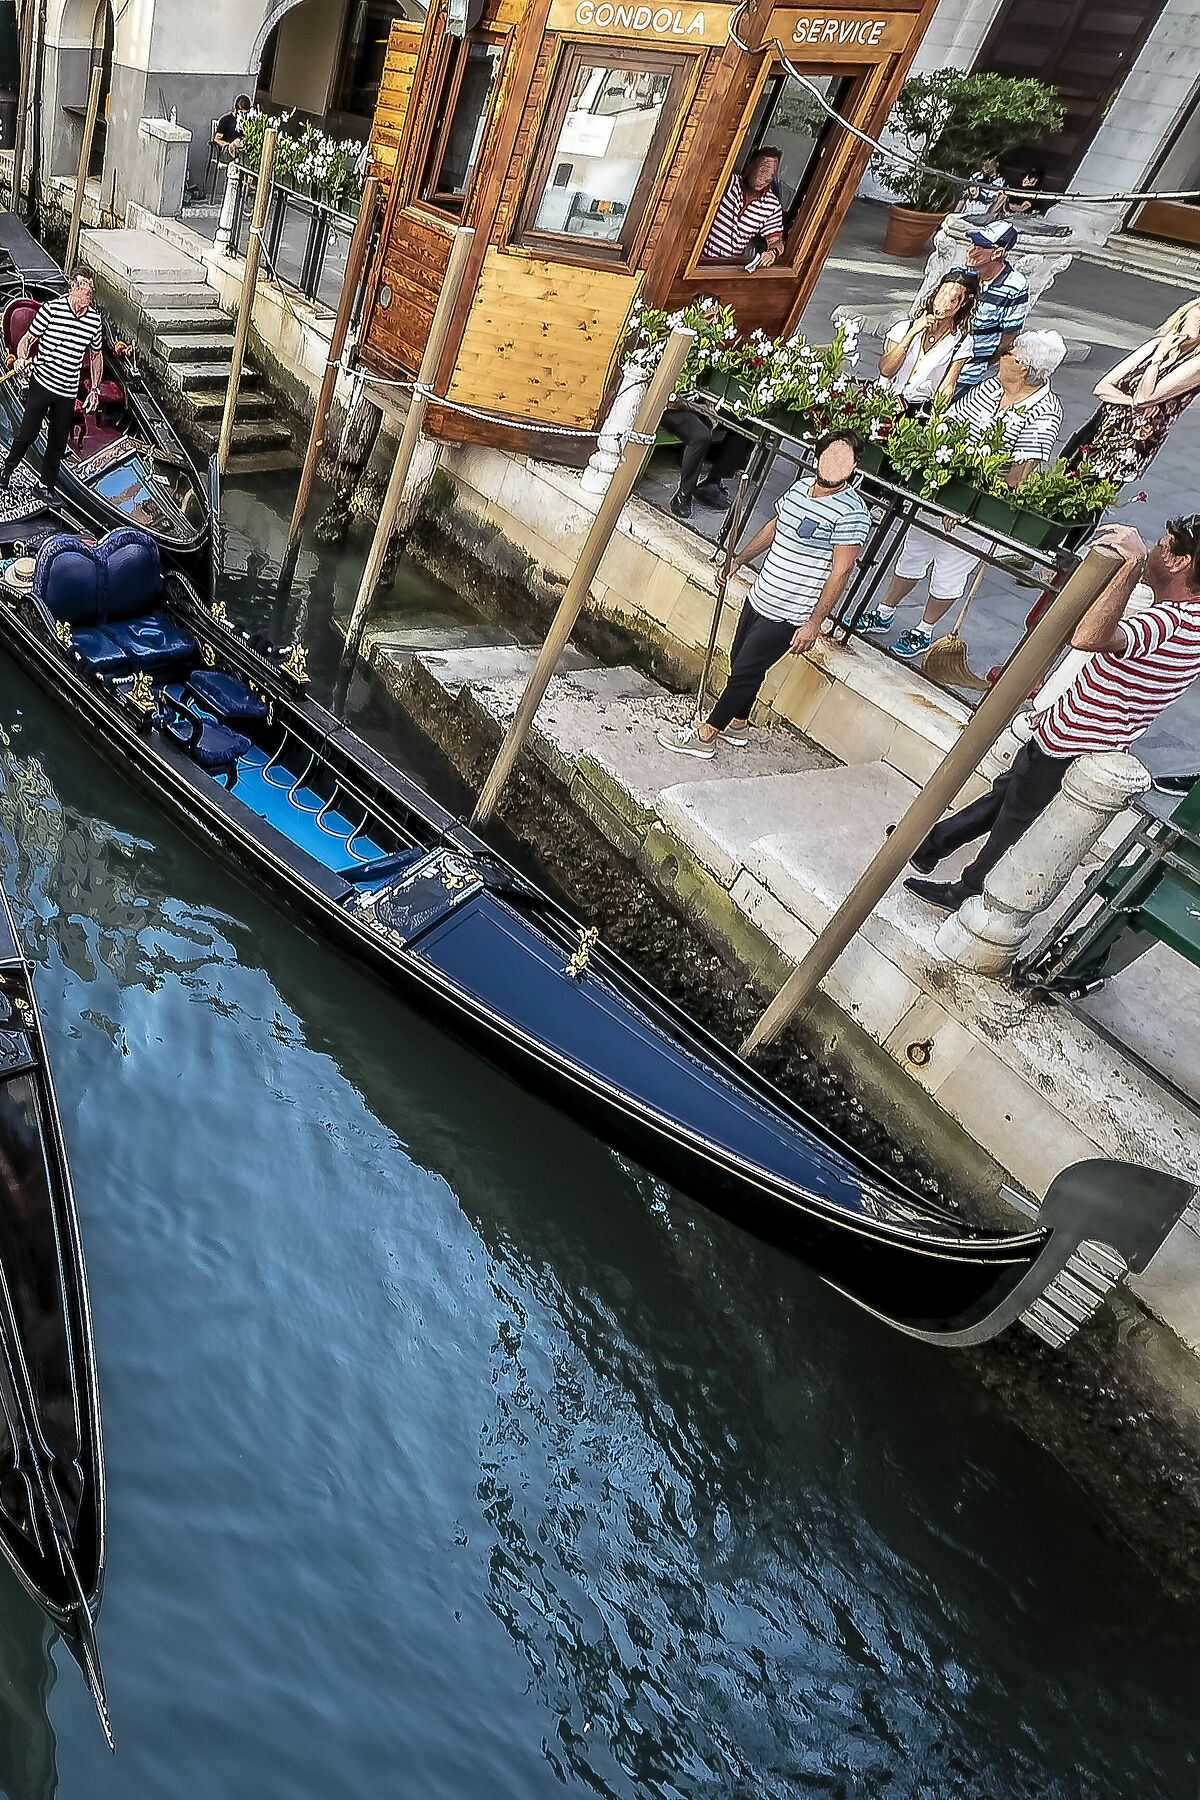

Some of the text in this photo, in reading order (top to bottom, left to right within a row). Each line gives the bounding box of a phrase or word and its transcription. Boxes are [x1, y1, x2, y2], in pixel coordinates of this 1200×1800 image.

[575, 0, 706, 36] GONDOLA
[792, 17, 887, 45] SERVICE
[23, 1009, 35, 1028] 182
